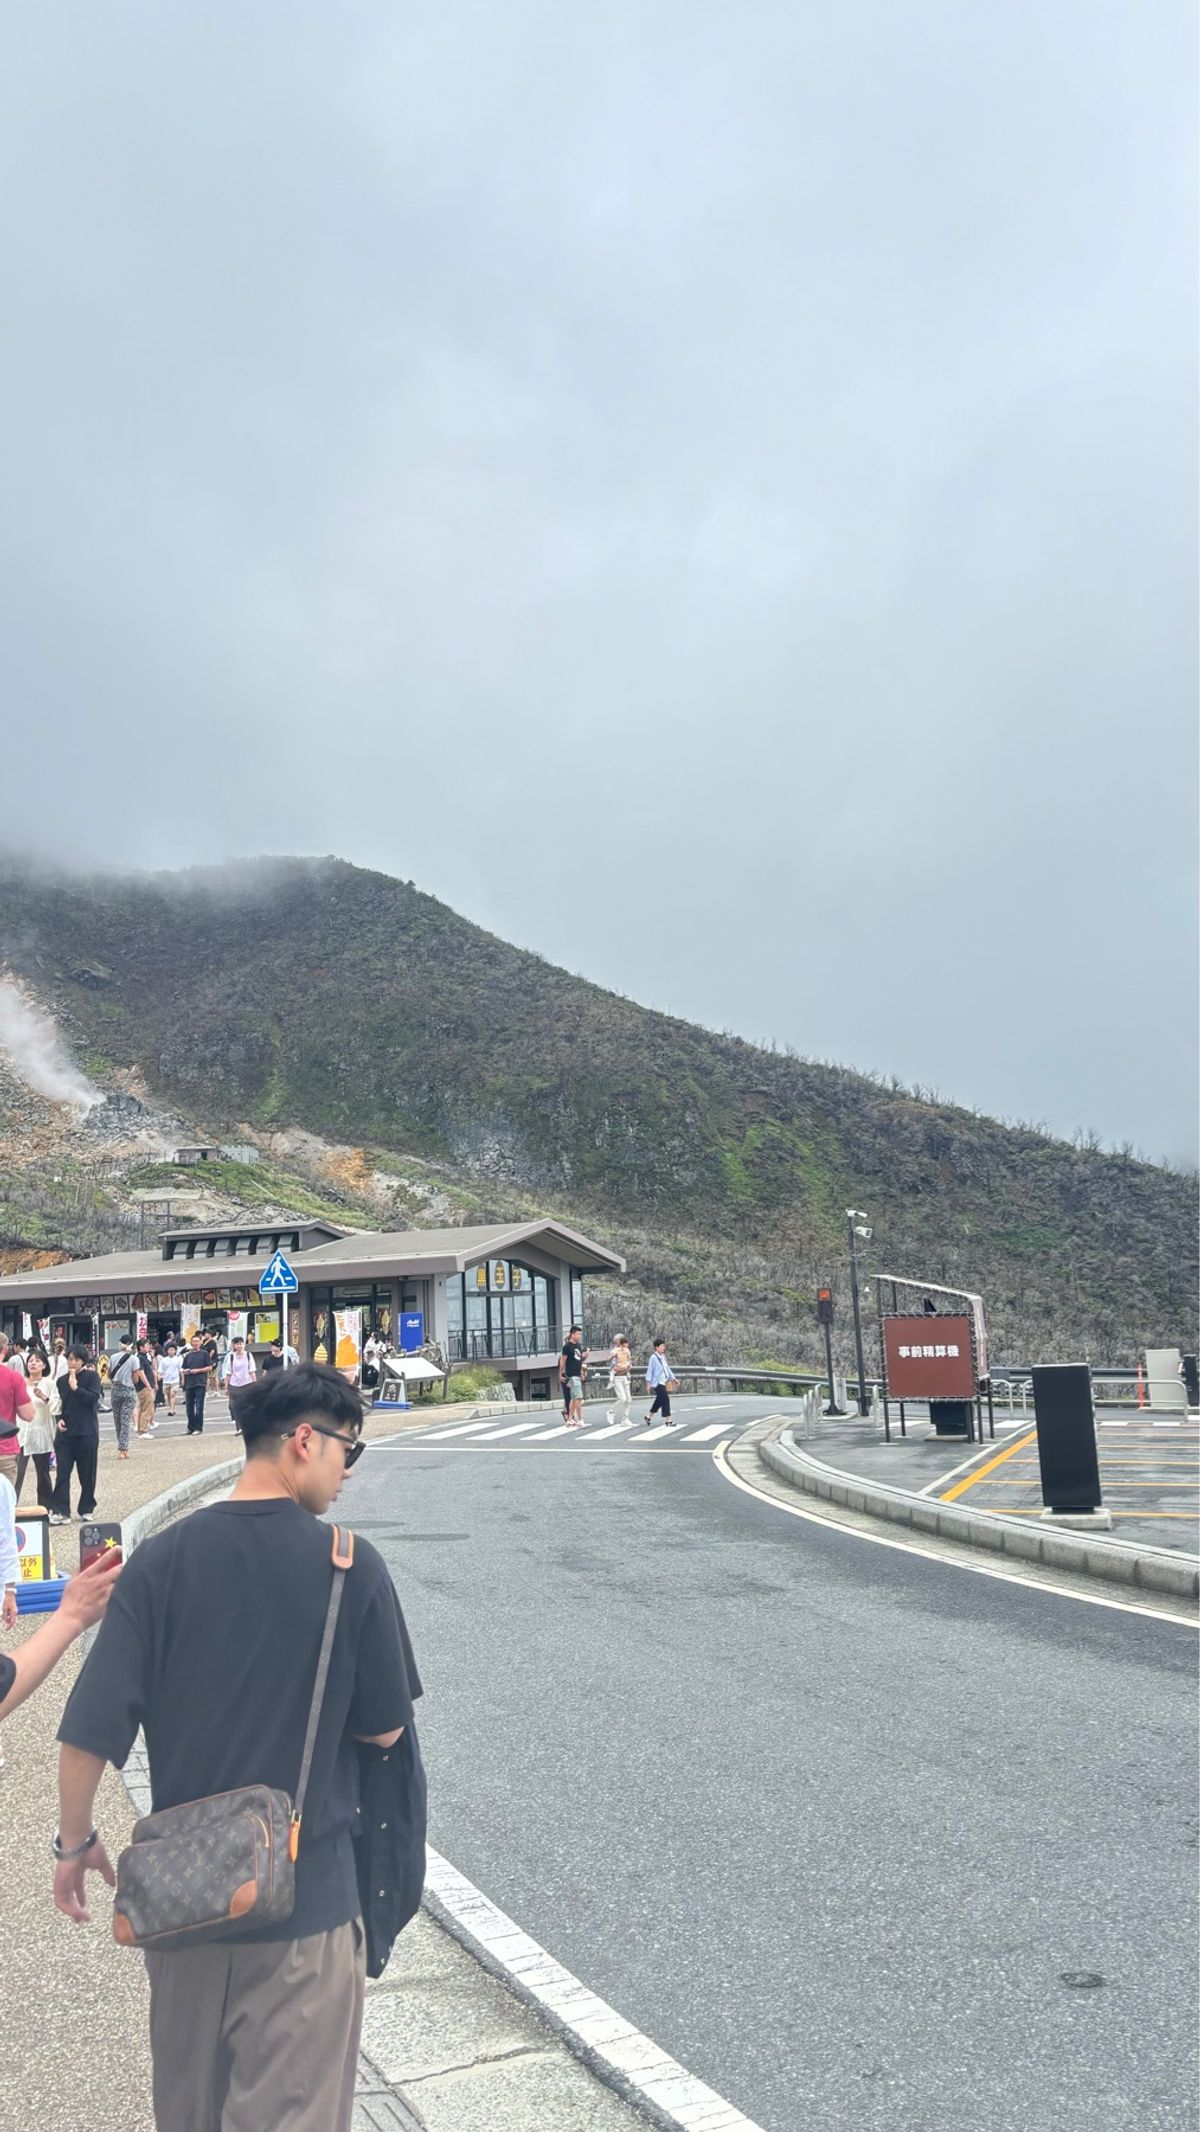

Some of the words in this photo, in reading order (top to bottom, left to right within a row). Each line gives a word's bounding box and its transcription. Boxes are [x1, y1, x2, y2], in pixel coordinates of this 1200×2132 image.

[477, 1267, 521, 1287] 黒玉子
[898, 1345, 959, 1358] 事前精算機
